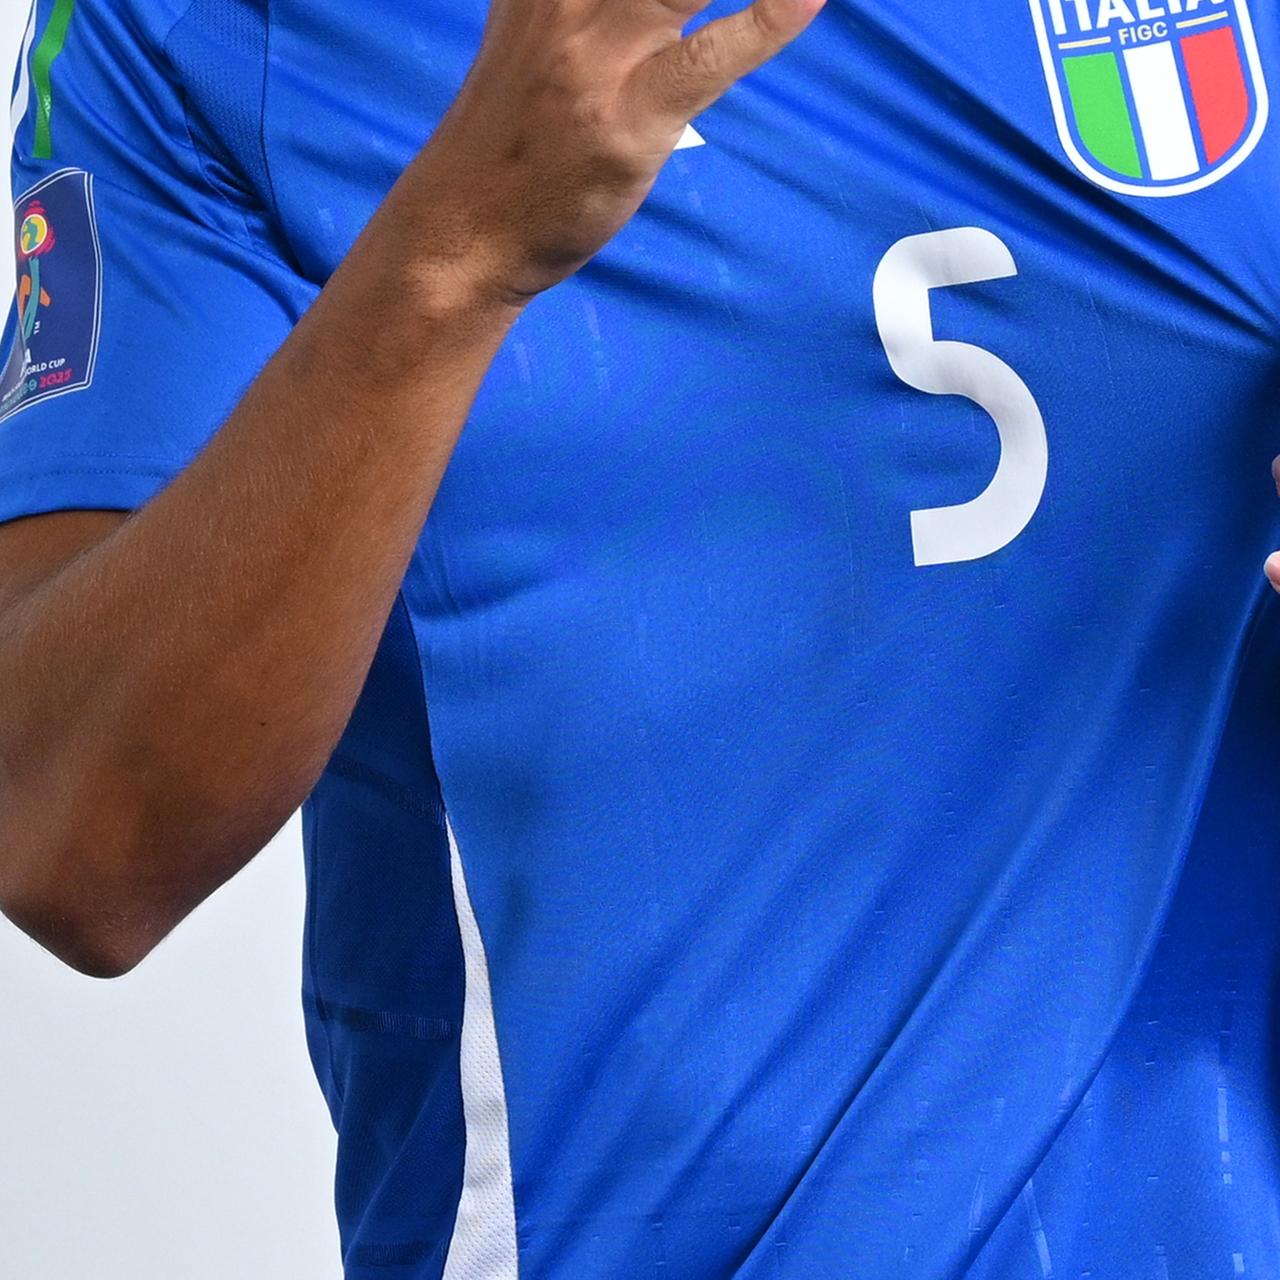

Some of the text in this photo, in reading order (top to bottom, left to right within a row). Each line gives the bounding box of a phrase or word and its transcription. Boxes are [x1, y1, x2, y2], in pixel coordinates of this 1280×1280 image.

[1117, 21, 1169, 45] FIGC
[48, 357, 66, 369] CUP
[873, 226, 1048, 567] 5
